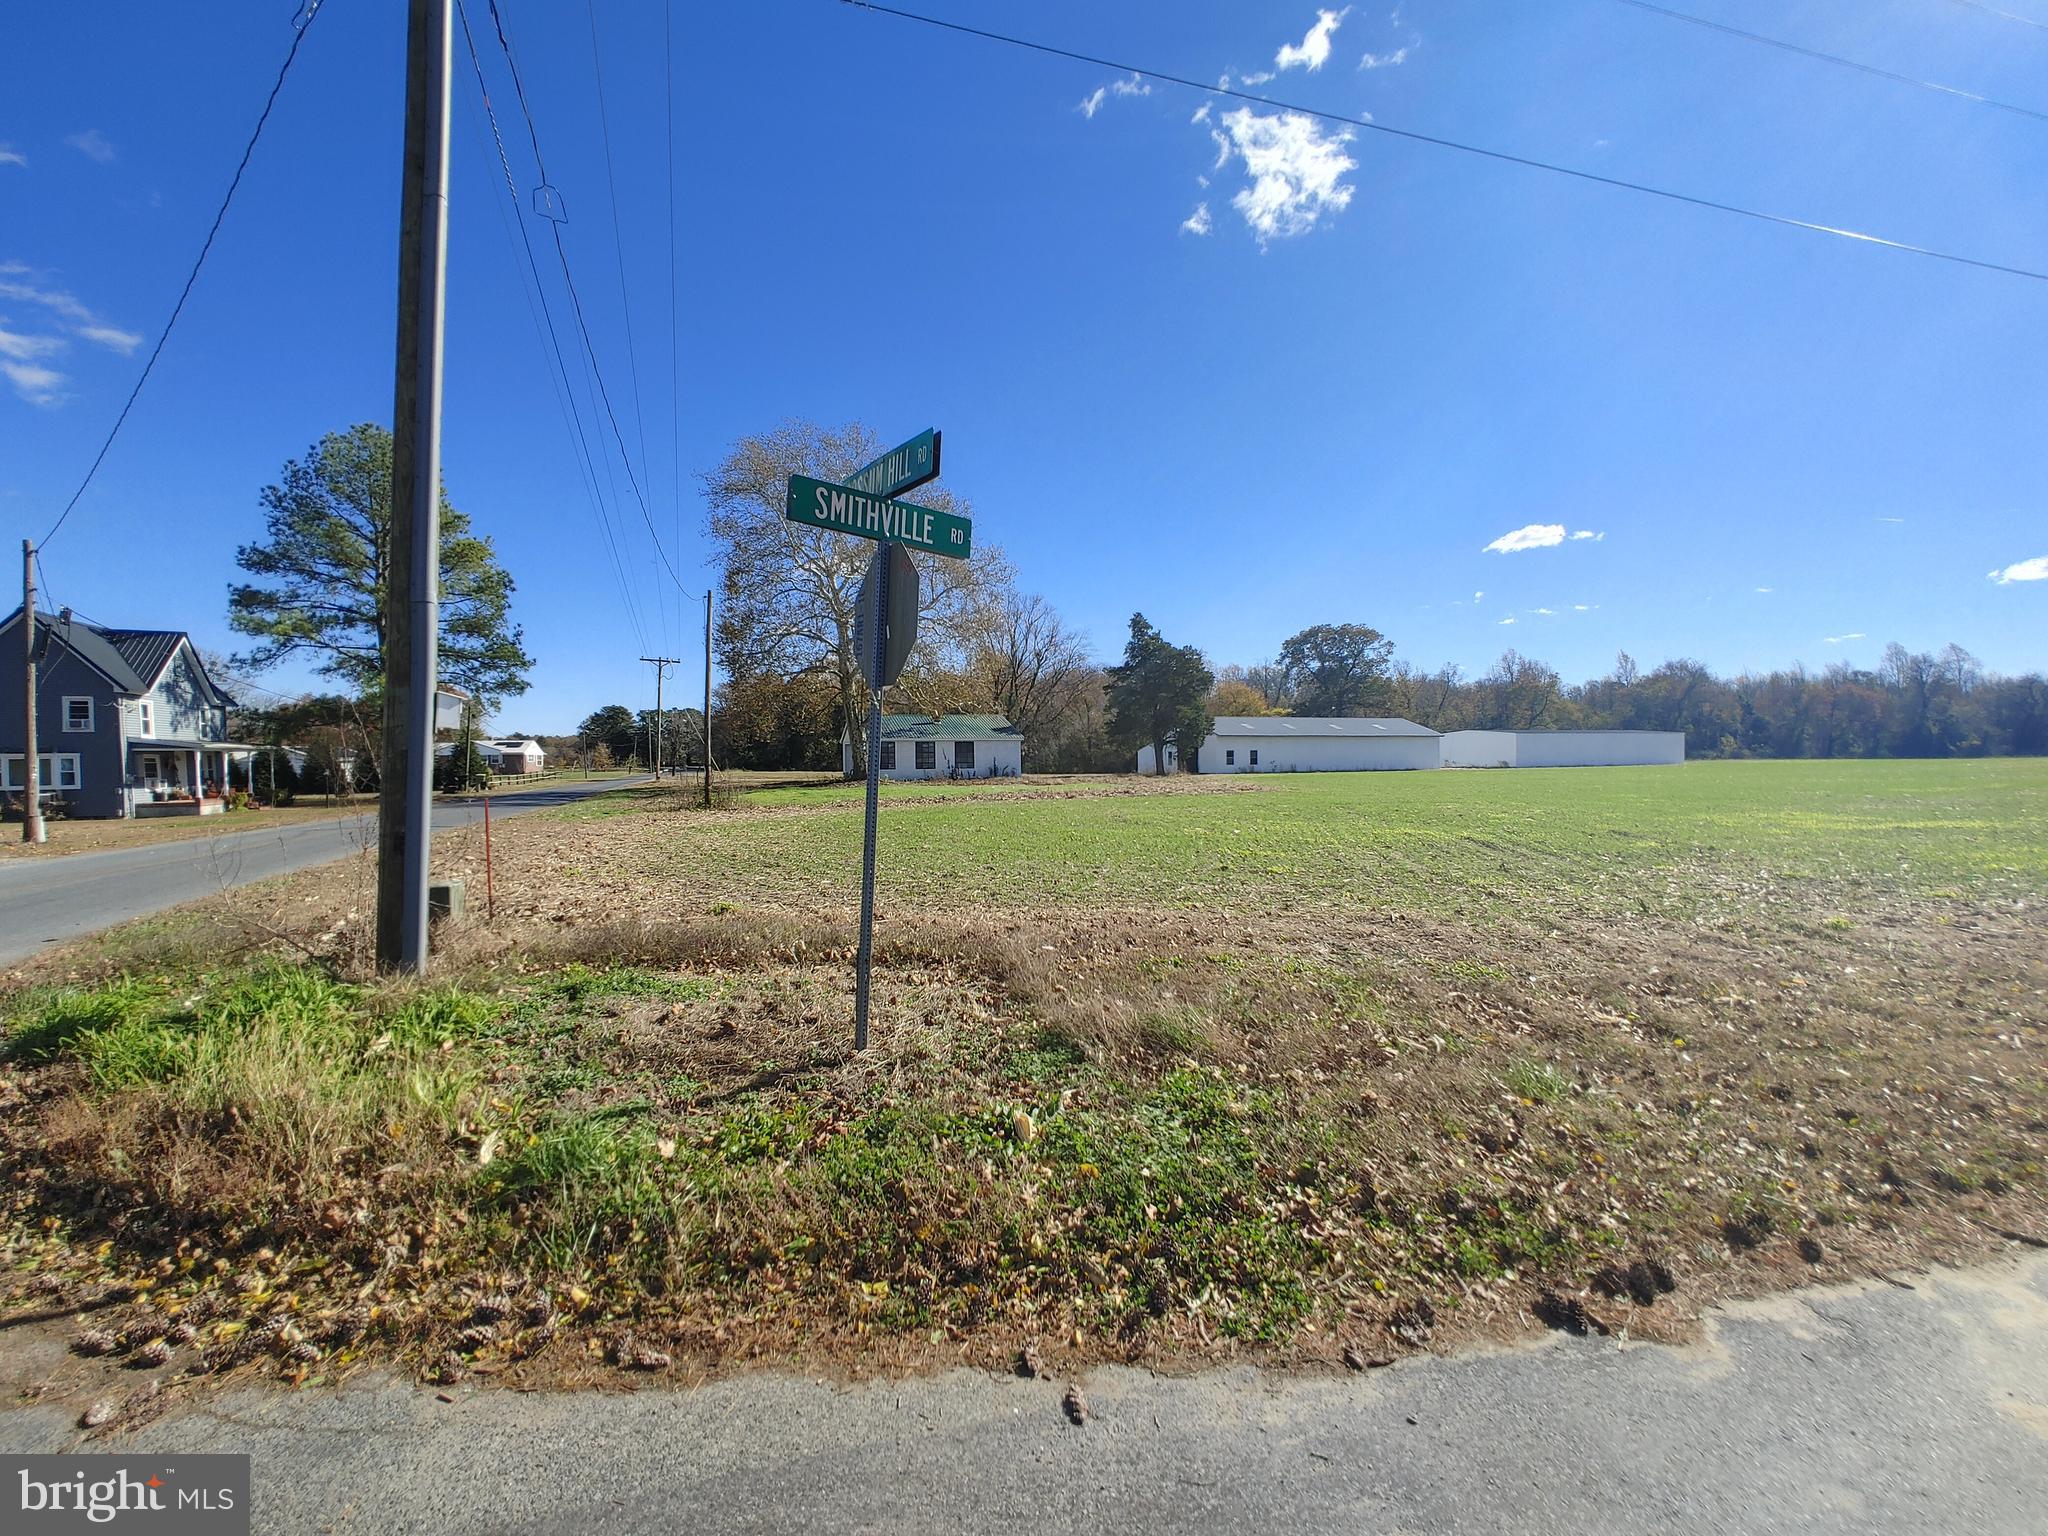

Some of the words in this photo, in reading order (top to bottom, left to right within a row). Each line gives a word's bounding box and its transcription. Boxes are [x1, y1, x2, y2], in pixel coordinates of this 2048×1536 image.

[848, 463, 883, 493] SSUM
[887, 448, 911, 487] HILL
[917, 446, 927, 464] RD
[814, 486, 935, 545] SMITHVILLE
[950, 527, 964, 545] RD
